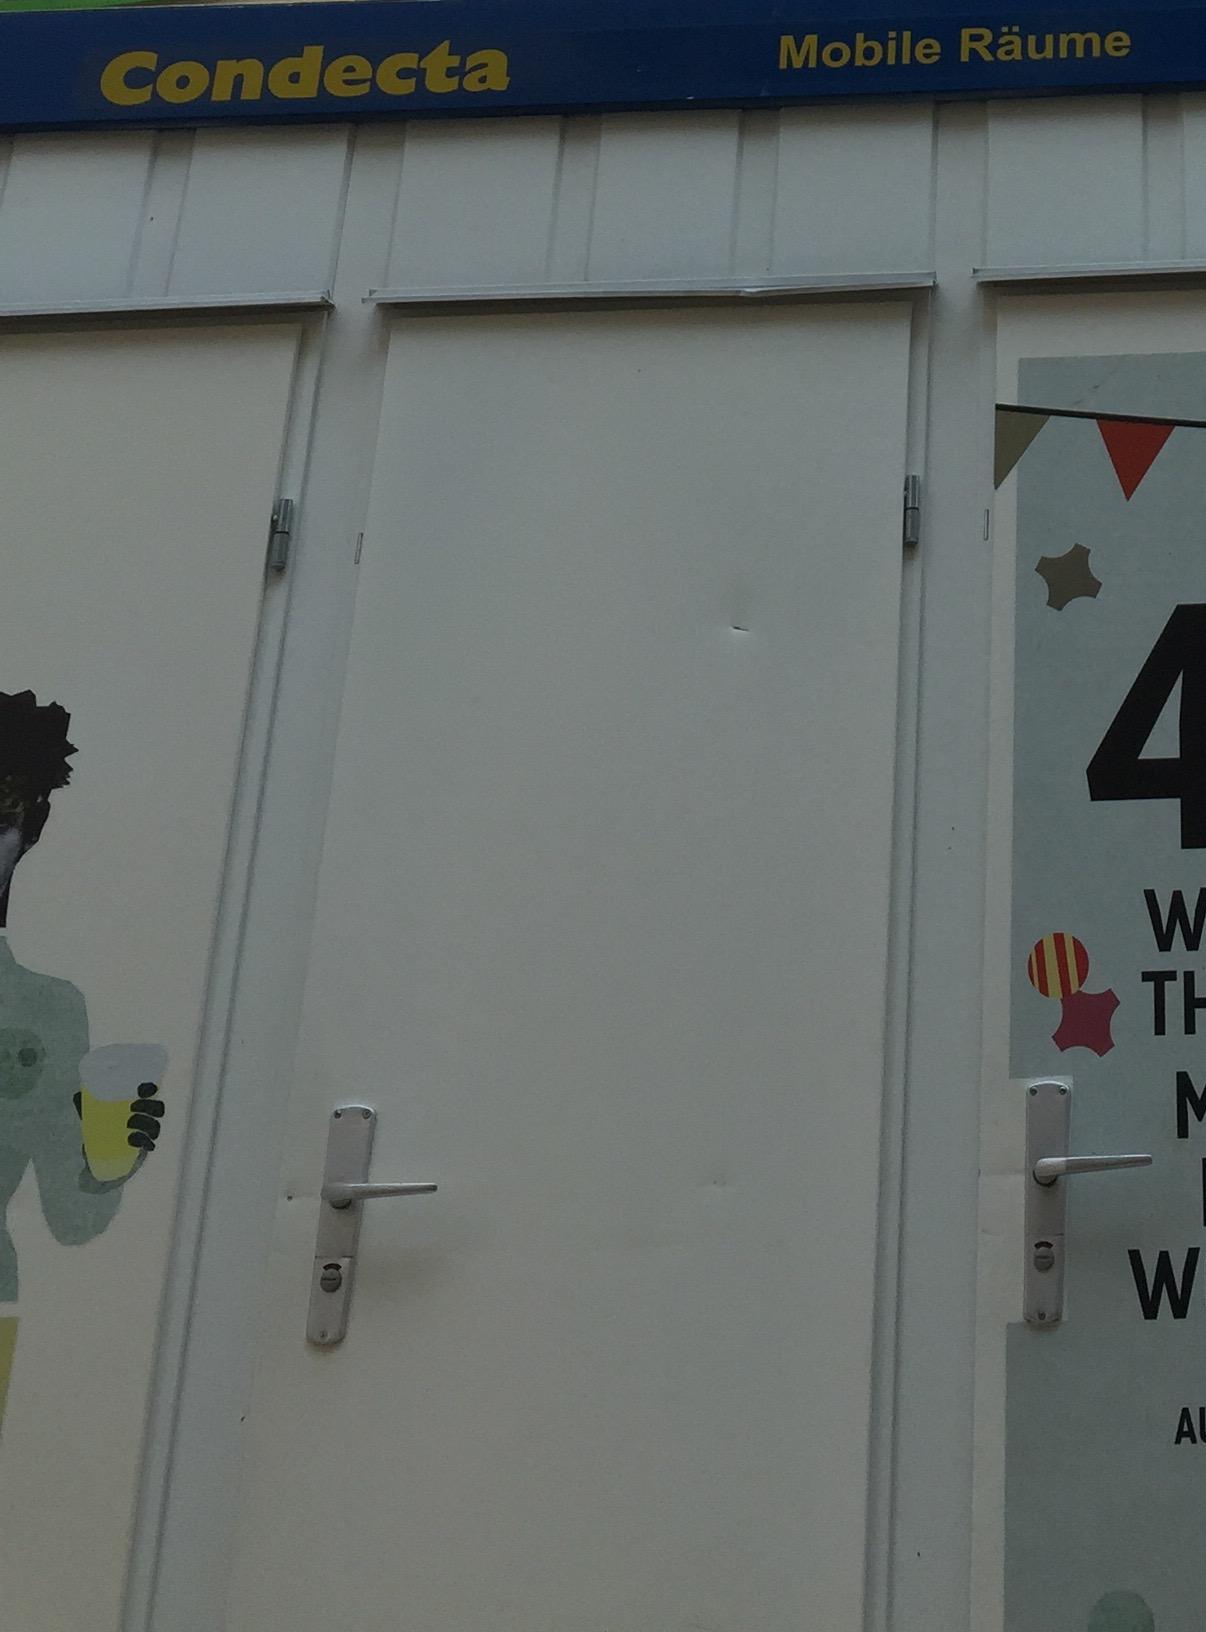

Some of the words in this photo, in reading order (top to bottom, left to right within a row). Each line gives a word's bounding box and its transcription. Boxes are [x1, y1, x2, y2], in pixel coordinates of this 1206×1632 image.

[100, 41, 509, 106] Condecta
[779, 31, 940, 69] Mobile
[960, 28, 1131, 62] Räume
